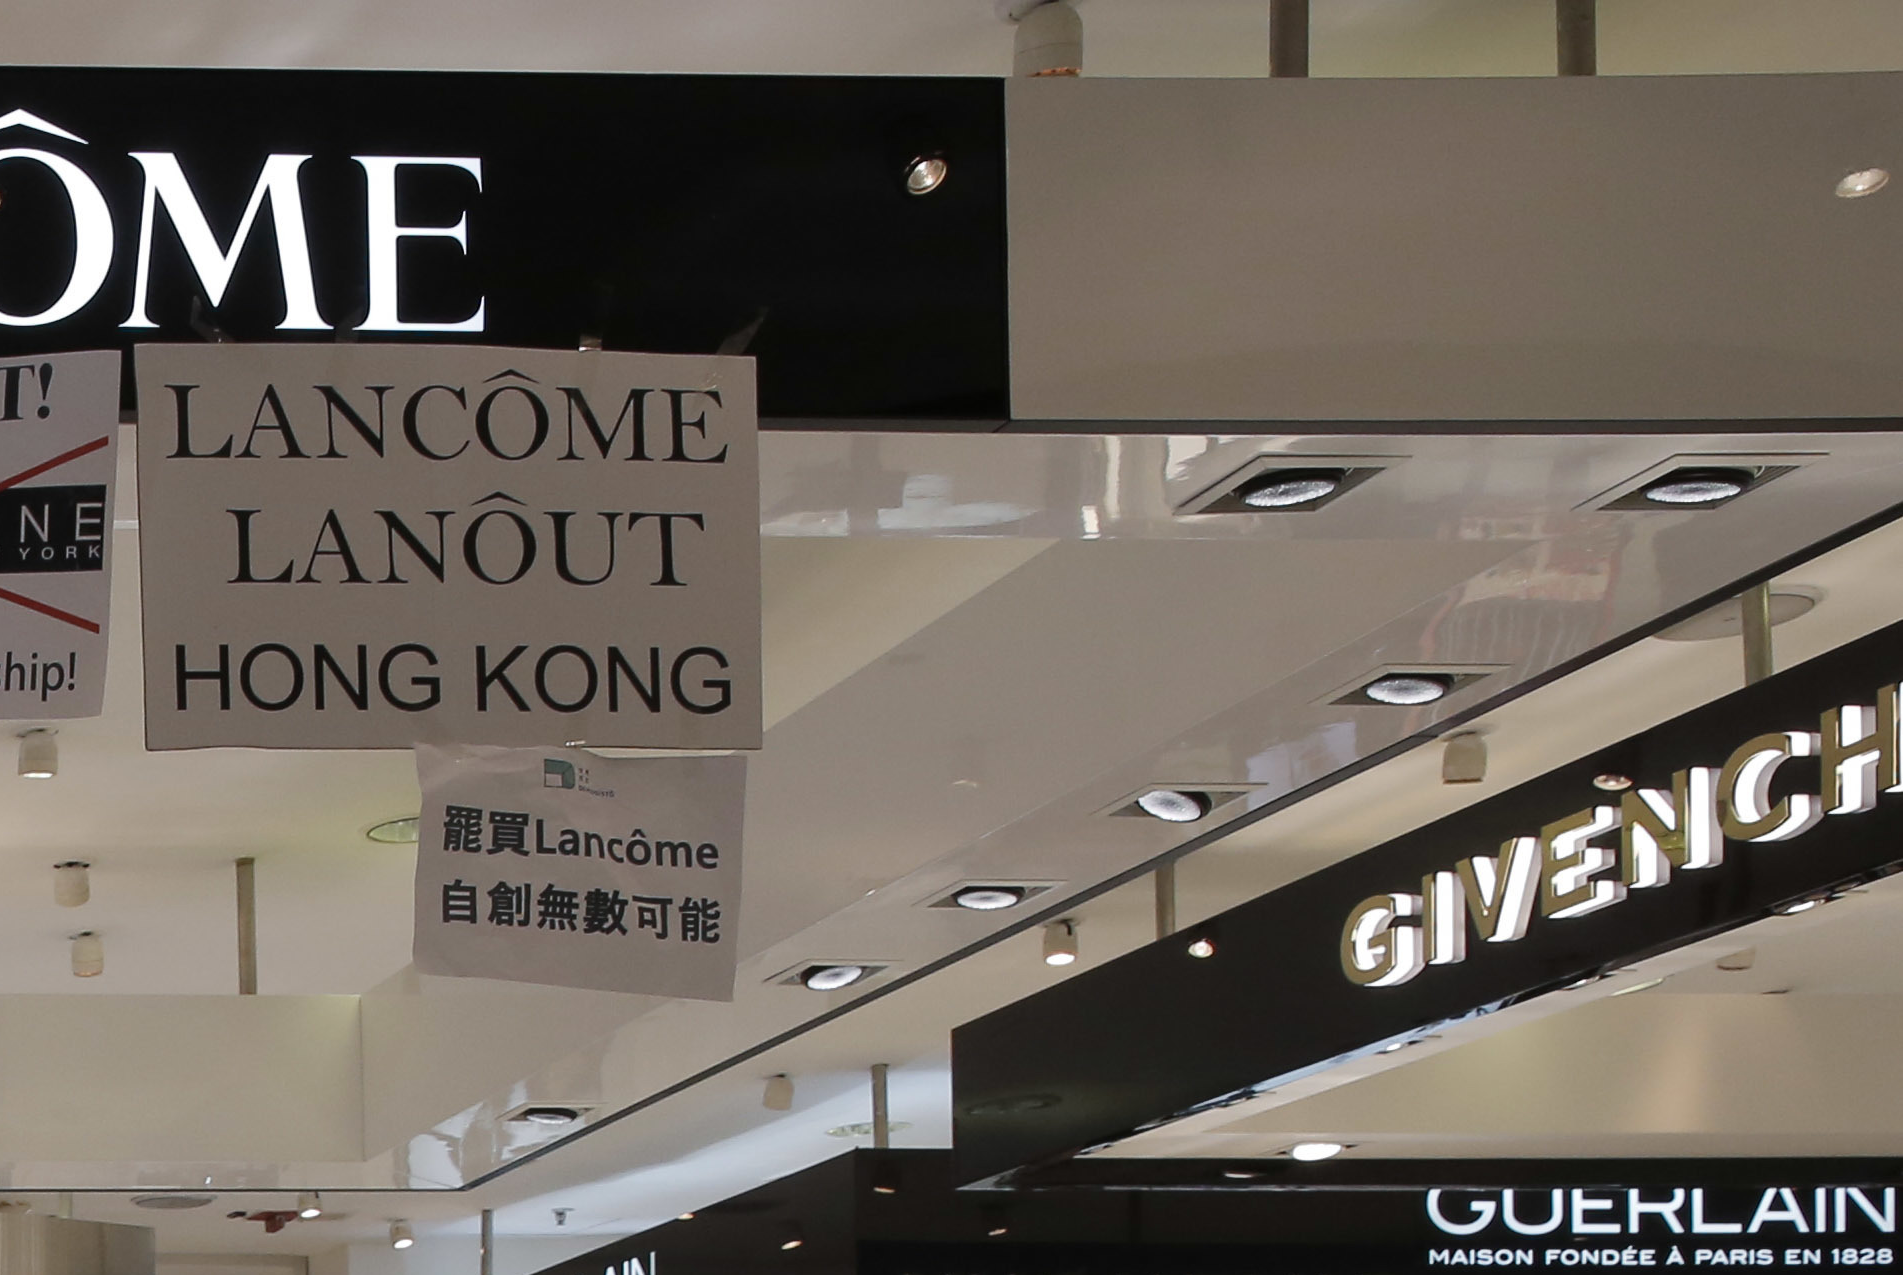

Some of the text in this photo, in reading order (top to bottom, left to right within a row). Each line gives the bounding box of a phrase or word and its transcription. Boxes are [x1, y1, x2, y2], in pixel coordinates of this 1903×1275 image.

[163, 369, 730, 464] LANCÔME
[18, 544, 102, 562] YORK
[225, 492, 706, 588] LANÔUT
[174, 642, 733, 715] HONG KONG
[440, 880, 722, 944] 自創無數可能
[1426, 1186, 1896, 1236] GUERLAIN
[1428, 1245, 1894, 1267] MAISON FONDÉE À PARIS EN 1828
